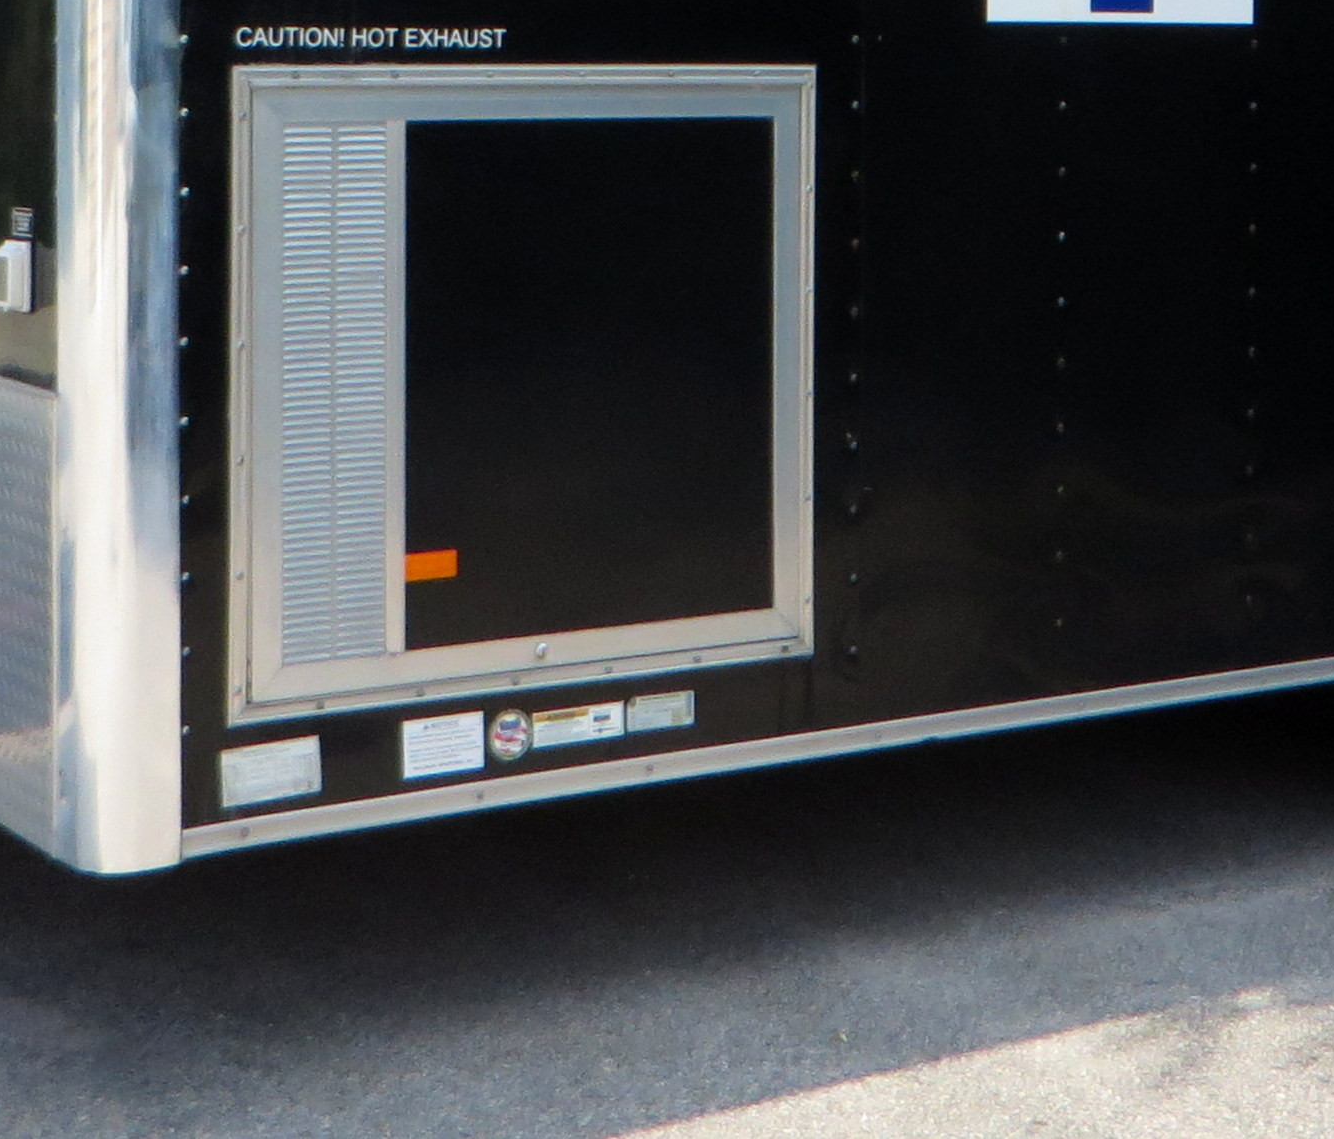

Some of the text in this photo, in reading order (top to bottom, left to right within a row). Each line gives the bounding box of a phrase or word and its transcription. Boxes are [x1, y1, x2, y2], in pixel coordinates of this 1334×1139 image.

[235, 26, 507, 48] CAUTION! HOT EXHAUST
